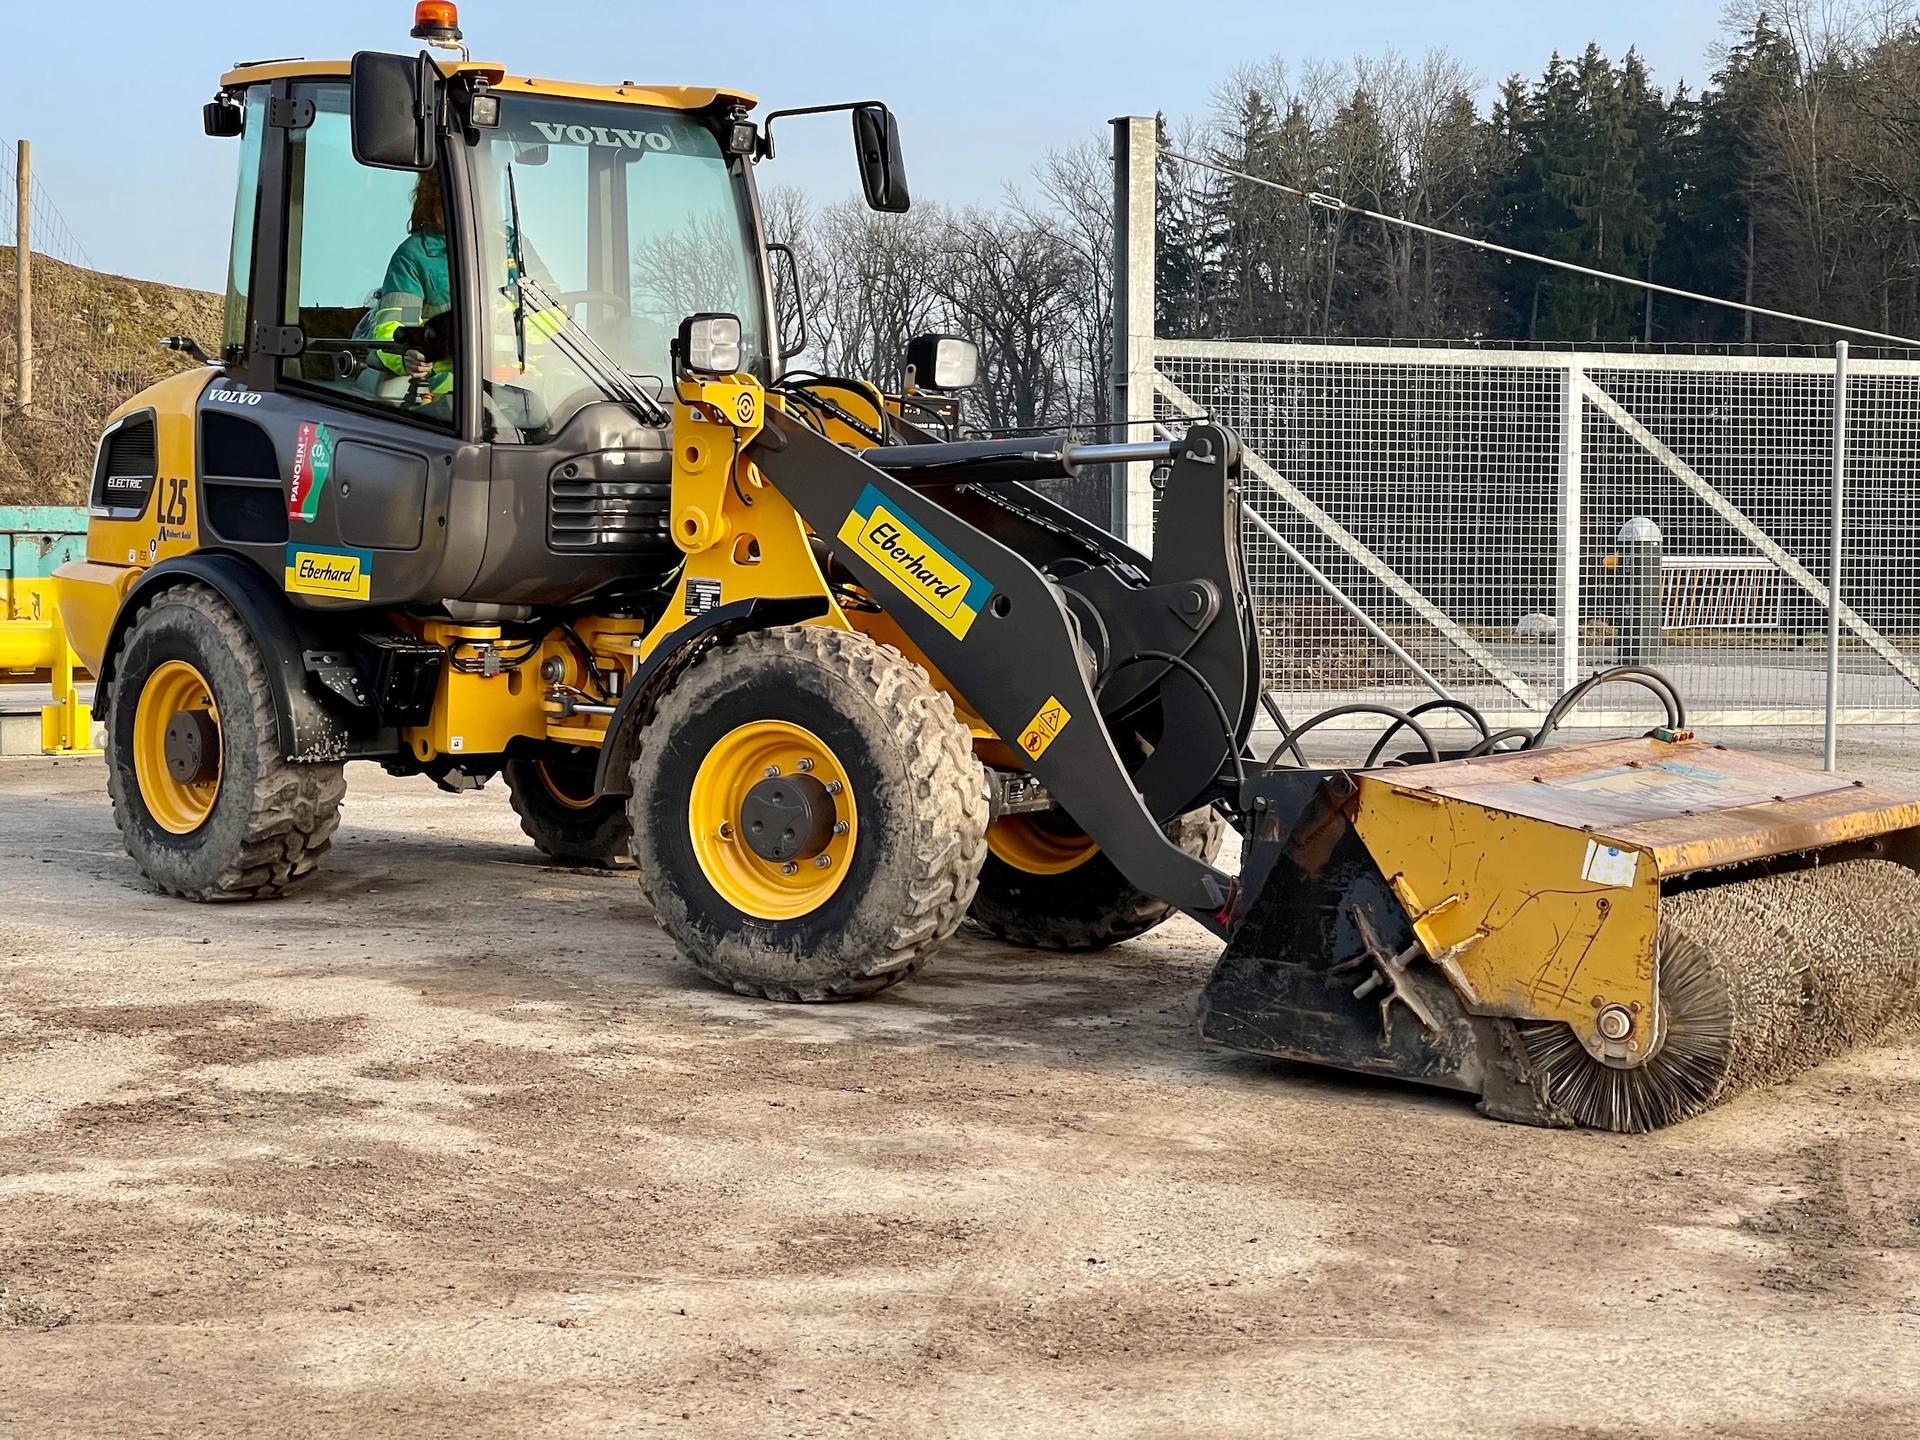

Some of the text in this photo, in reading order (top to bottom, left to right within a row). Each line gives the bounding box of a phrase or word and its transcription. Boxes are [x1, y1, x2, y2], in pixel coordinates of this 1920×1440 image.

[530, 121, 672, 151] VOLVO
[208, 389, 262, 406] VOLVO
[107, 478, 143, 489] ELECTRIC
[290, 443, 305, 502] PANOLIN
[157, 477, 188, 526] L25
[299, 559, 355, 582] Eberhard
[868, 522, 961, 600] Eberhard
